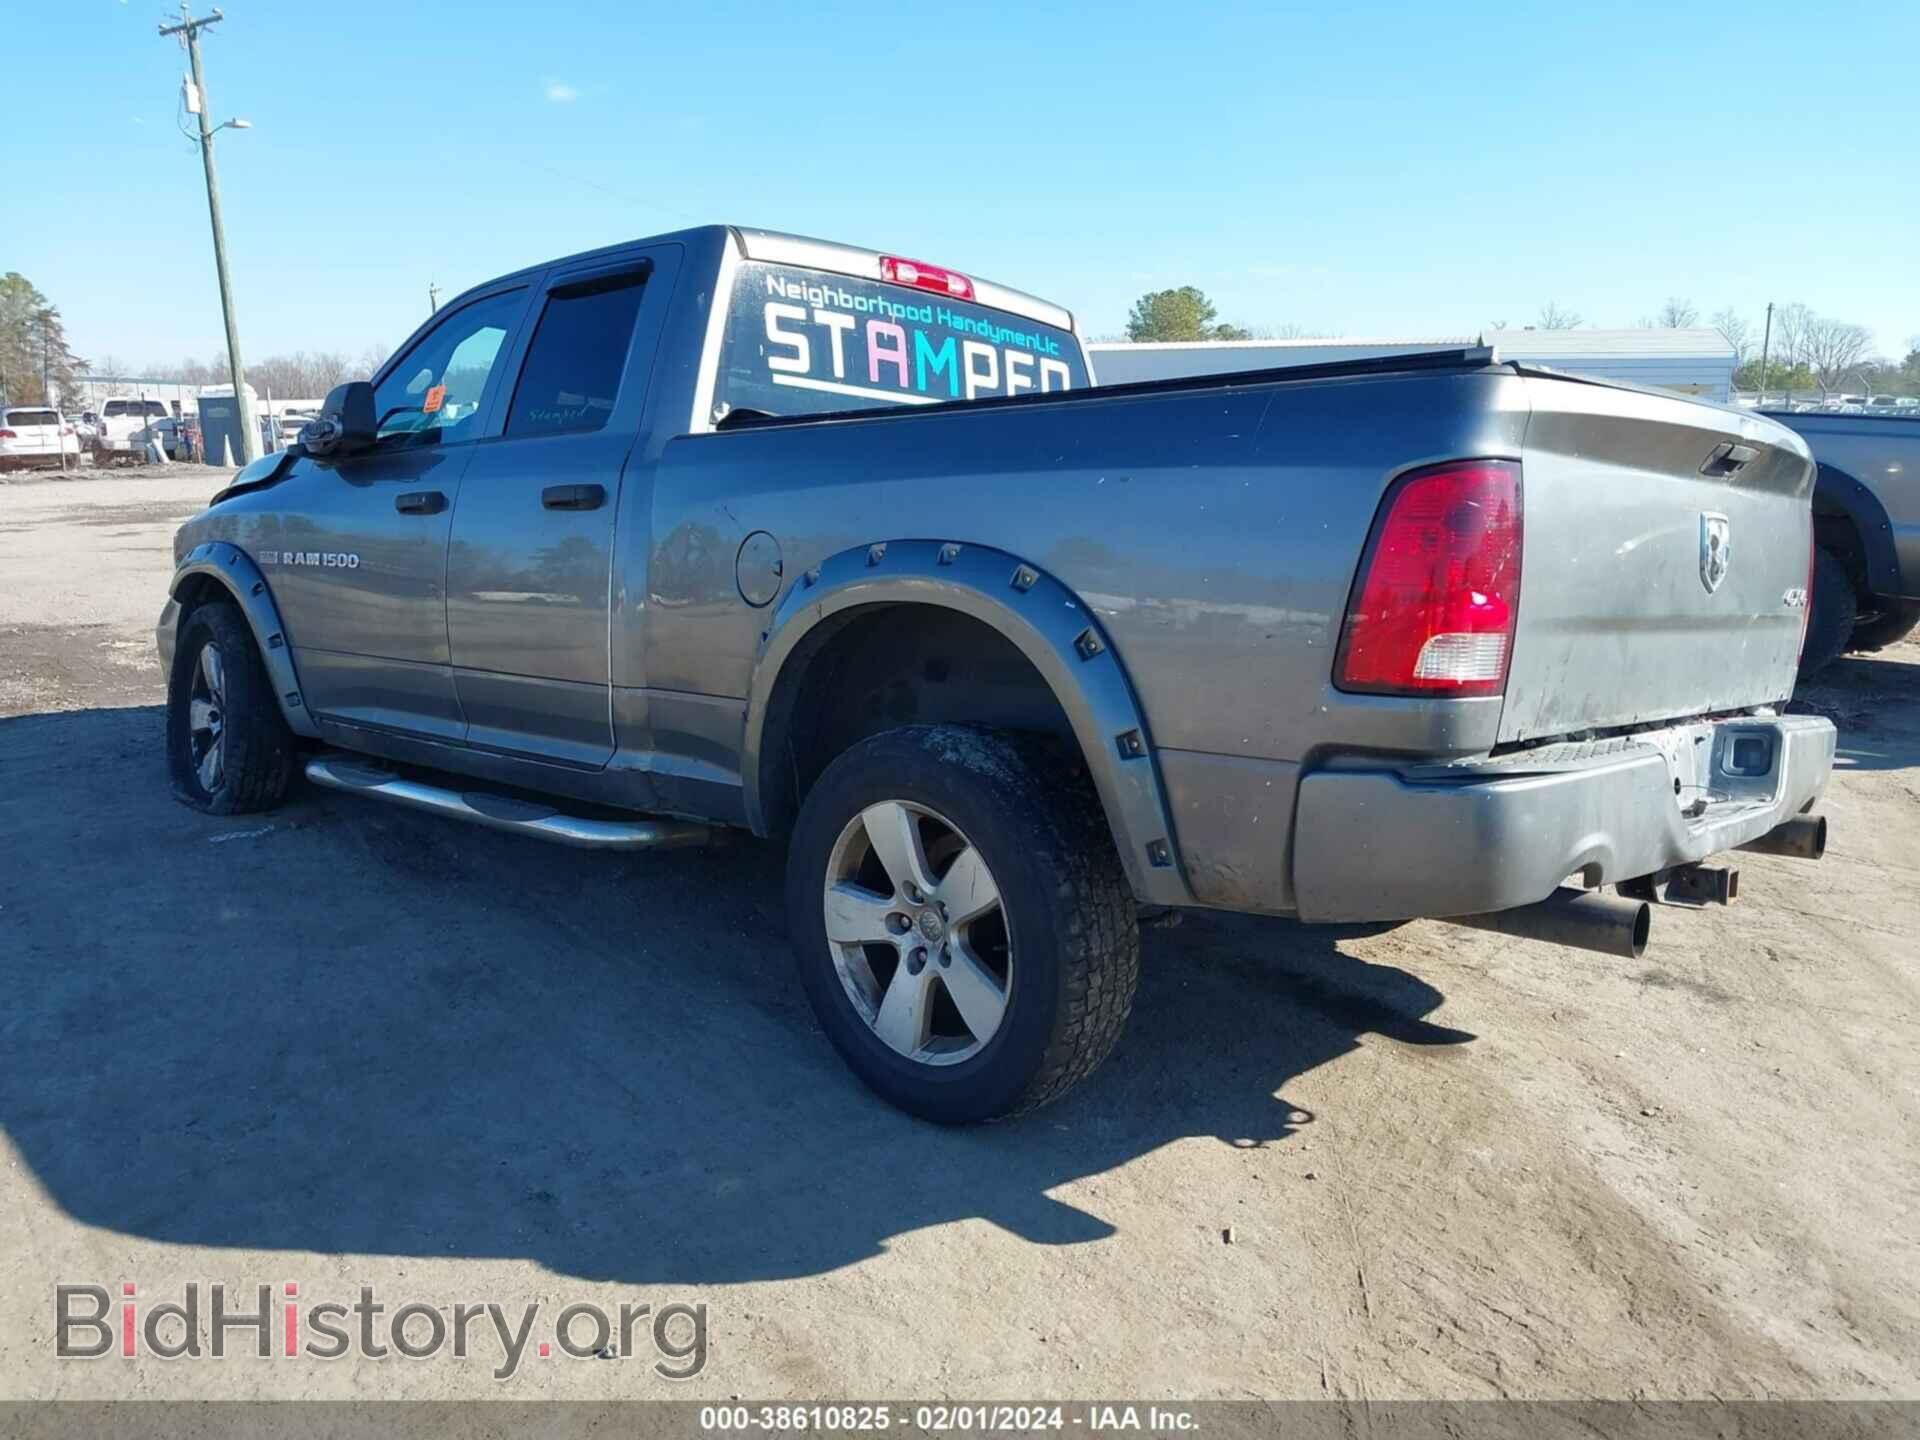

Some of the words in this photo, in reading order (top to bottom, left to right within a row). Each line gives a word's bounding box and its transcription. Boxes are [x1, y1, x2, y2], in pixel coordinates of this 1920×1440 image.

[766, 275, 931, 324] Neighborhood
[283, 552, 320, 566] RAM
[322, 553, 360, 569] 1500
